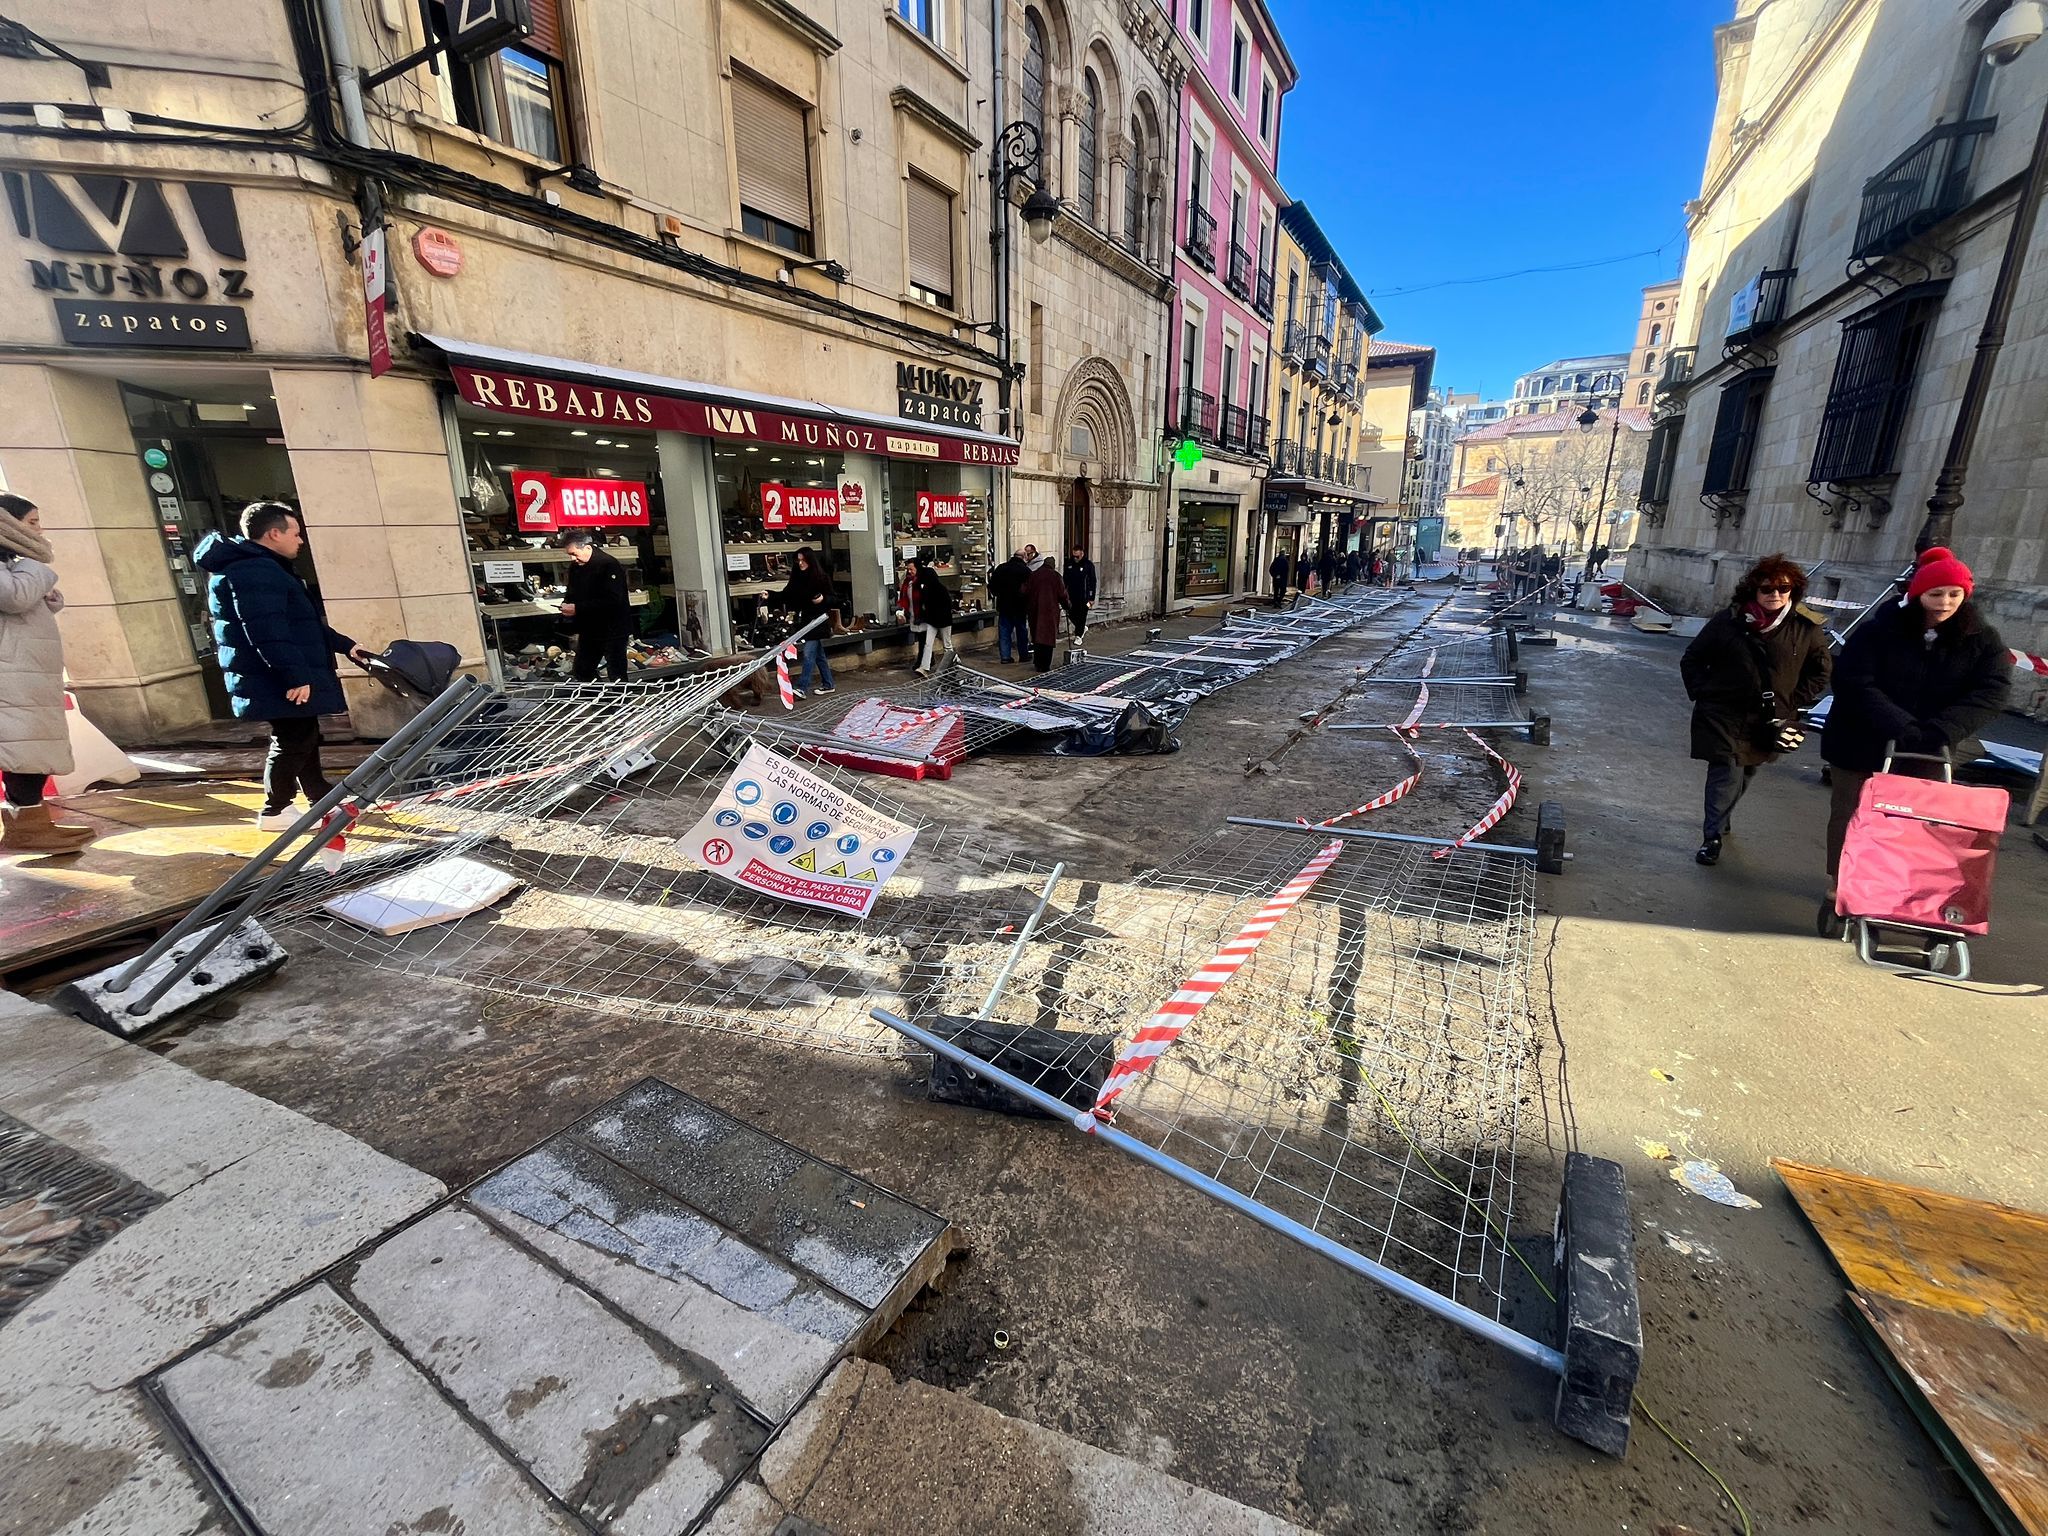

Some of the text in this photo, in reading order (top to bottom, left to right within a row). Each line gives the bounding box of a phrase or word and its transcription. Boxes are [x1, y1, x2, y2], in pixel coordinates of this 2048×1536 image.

[75, 312, 228, 333] zapatos
[470, 373, 653, 423] REBAJAS
[904, 398, 981, 425] zapatos
[781, 420, 876, 450] MUÑOZ
[890, 440, 936, 454] zapatos
[963, 443, 1020, 463] REBAJAS
[521, 480, 642, 523] 2 REBAJAS
[765, 490, 836, 523] 2 REBAJAS
[919, 496, 964, 523] 2 REBAJAS
[765, 757, 901, 834] ES OBLIGATORIO SEGUIR TODAS
[767, 772, 887, 840] LAS NORMAS DE SEGURIDAD
[743, 871, 785, 892] PERSONA
[785, 886, 814, 898] AJENA
[814, 891, 821, 899] A
[822, 892, 834, 900] LA
[835, 895, 861, 907] OBRA
[748, 862, 798, 885] PROHIBIDO
[797, 880, 808, 888] EL
[809, 882, 834, 893] PASO
[834, 885, 841, 893] A
[843, 887, 867, 898] TODA
